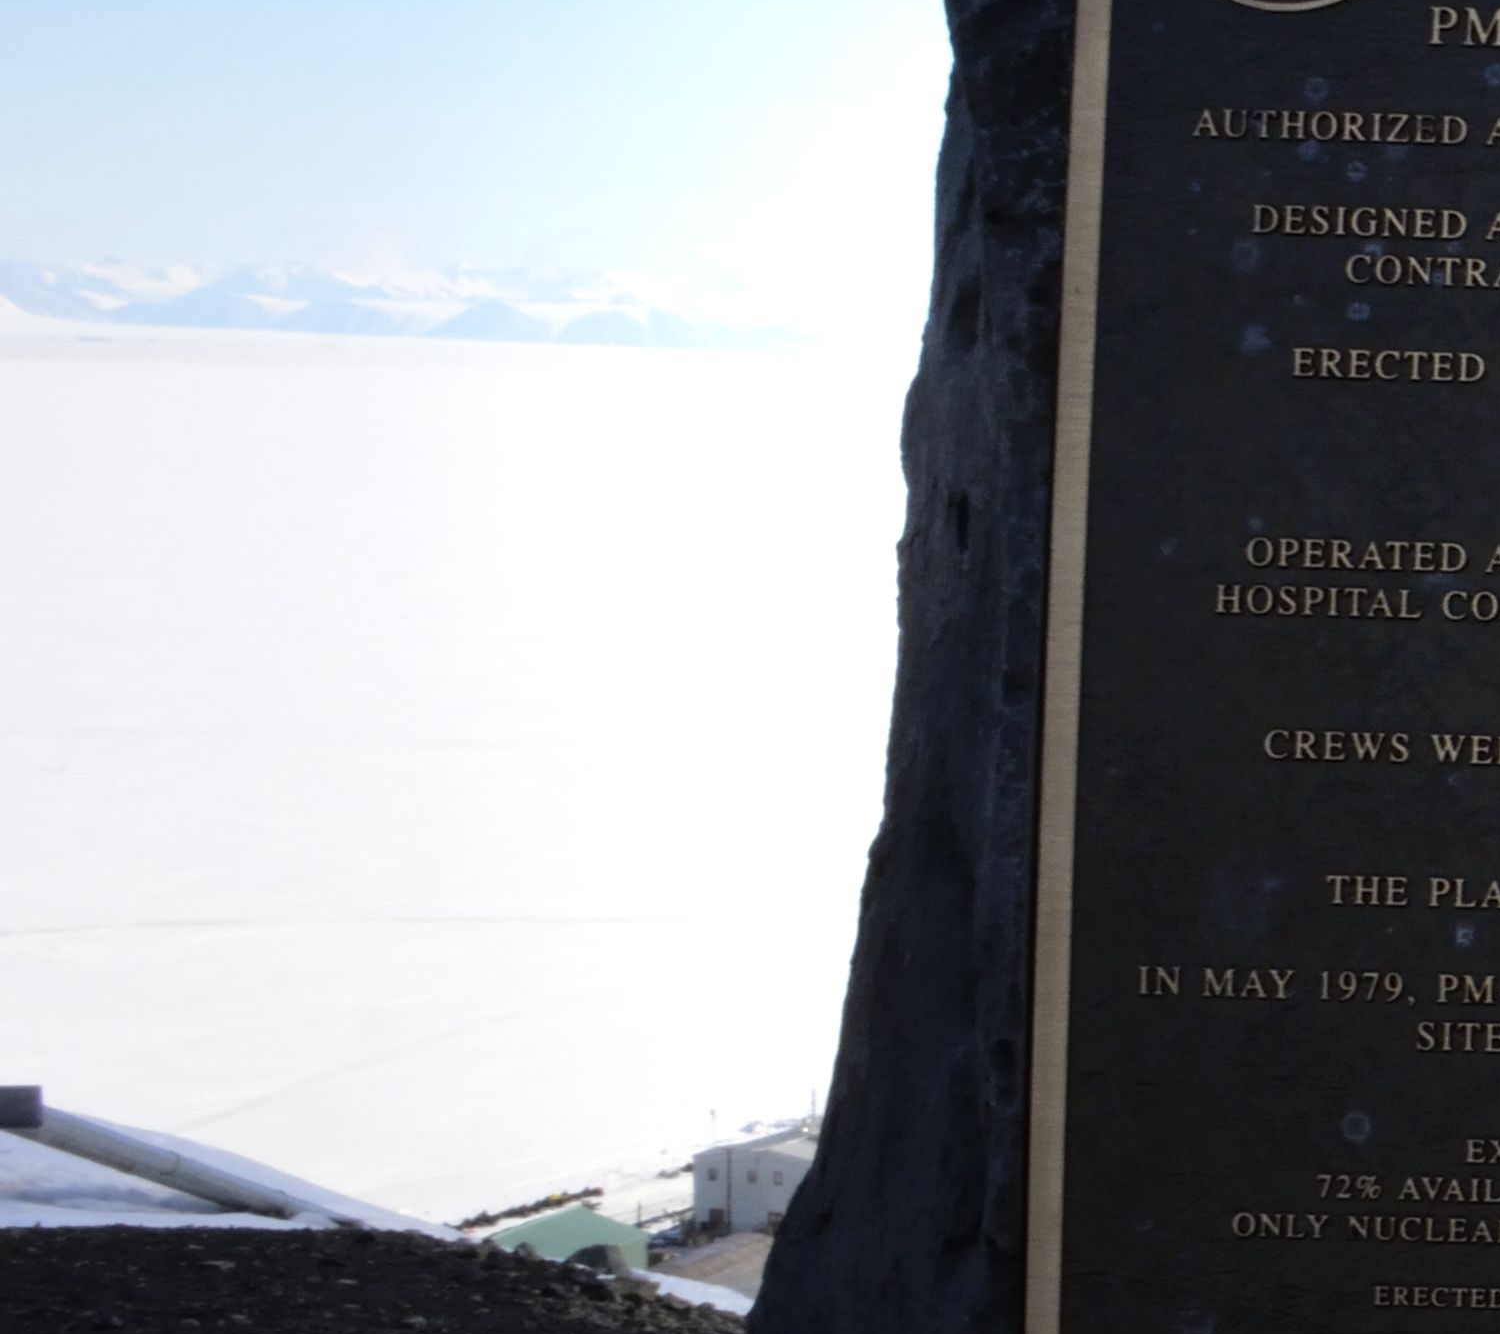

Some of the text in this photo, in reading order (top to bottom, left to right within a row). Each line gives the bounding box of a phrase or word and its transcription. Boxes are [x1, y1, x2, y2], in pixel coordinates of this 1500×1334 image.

[1193, 109, 1467, 143] AUTHORIZED
[1253, 205, 1467, 238] DESIGNED
[1294, 348, 1484, 381] ERECTED
[1246, 538, 1466, 571] OPERATED
[1216, 585, 1420, 618] HOSPITAL
[1264, 730, 1409, 761] CREWS
[1326, 875, 1407, 905] THE
[1139, 966, 1179, 994] IN
[1204, 968, 1293, 998] MAY
[1321, 971, 1414, 1003] 1979,
[1317, 1174, 1380, 1198] 72%
[1232, 1212, 1328, 1237] ONLY
